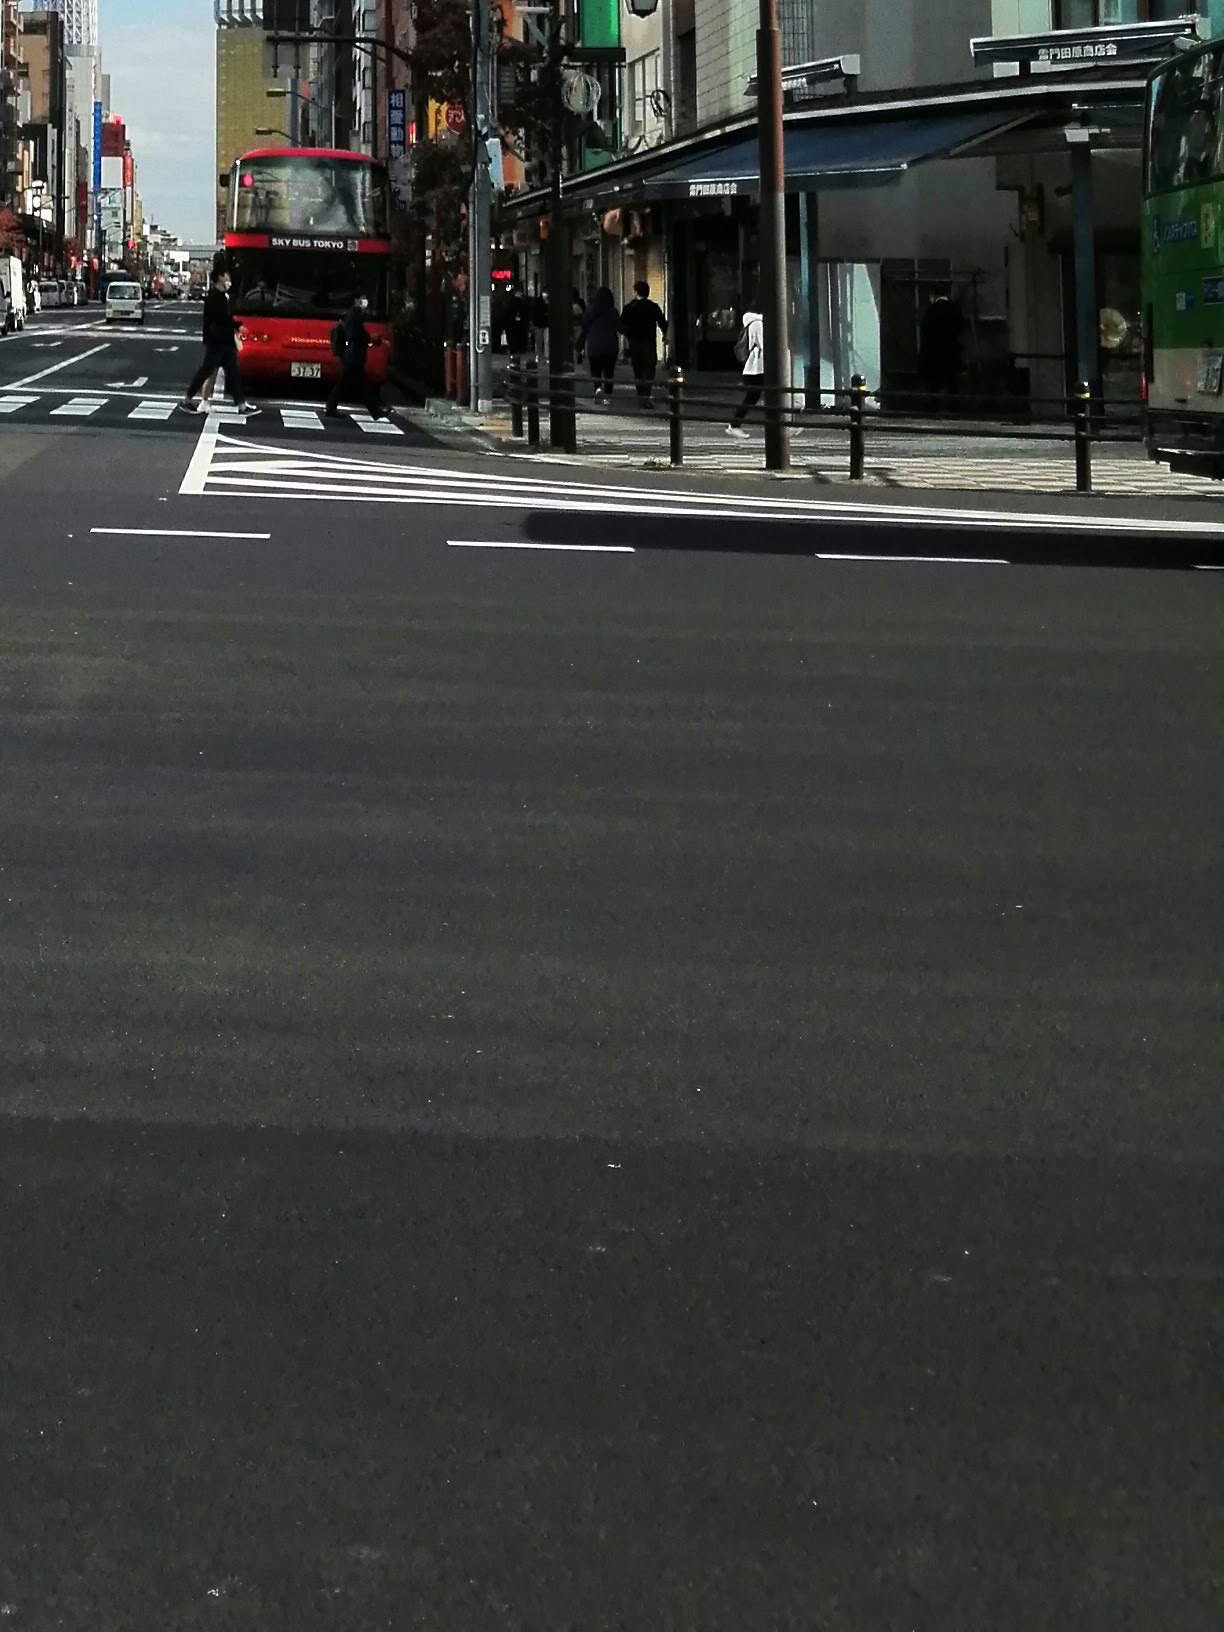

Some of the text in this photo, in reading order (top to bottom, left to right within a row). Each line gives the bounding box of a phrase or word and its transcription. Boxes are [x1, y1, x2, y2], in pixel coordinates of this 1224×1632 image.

[272, 237, 344, 249] SKY BUS TOKYO
